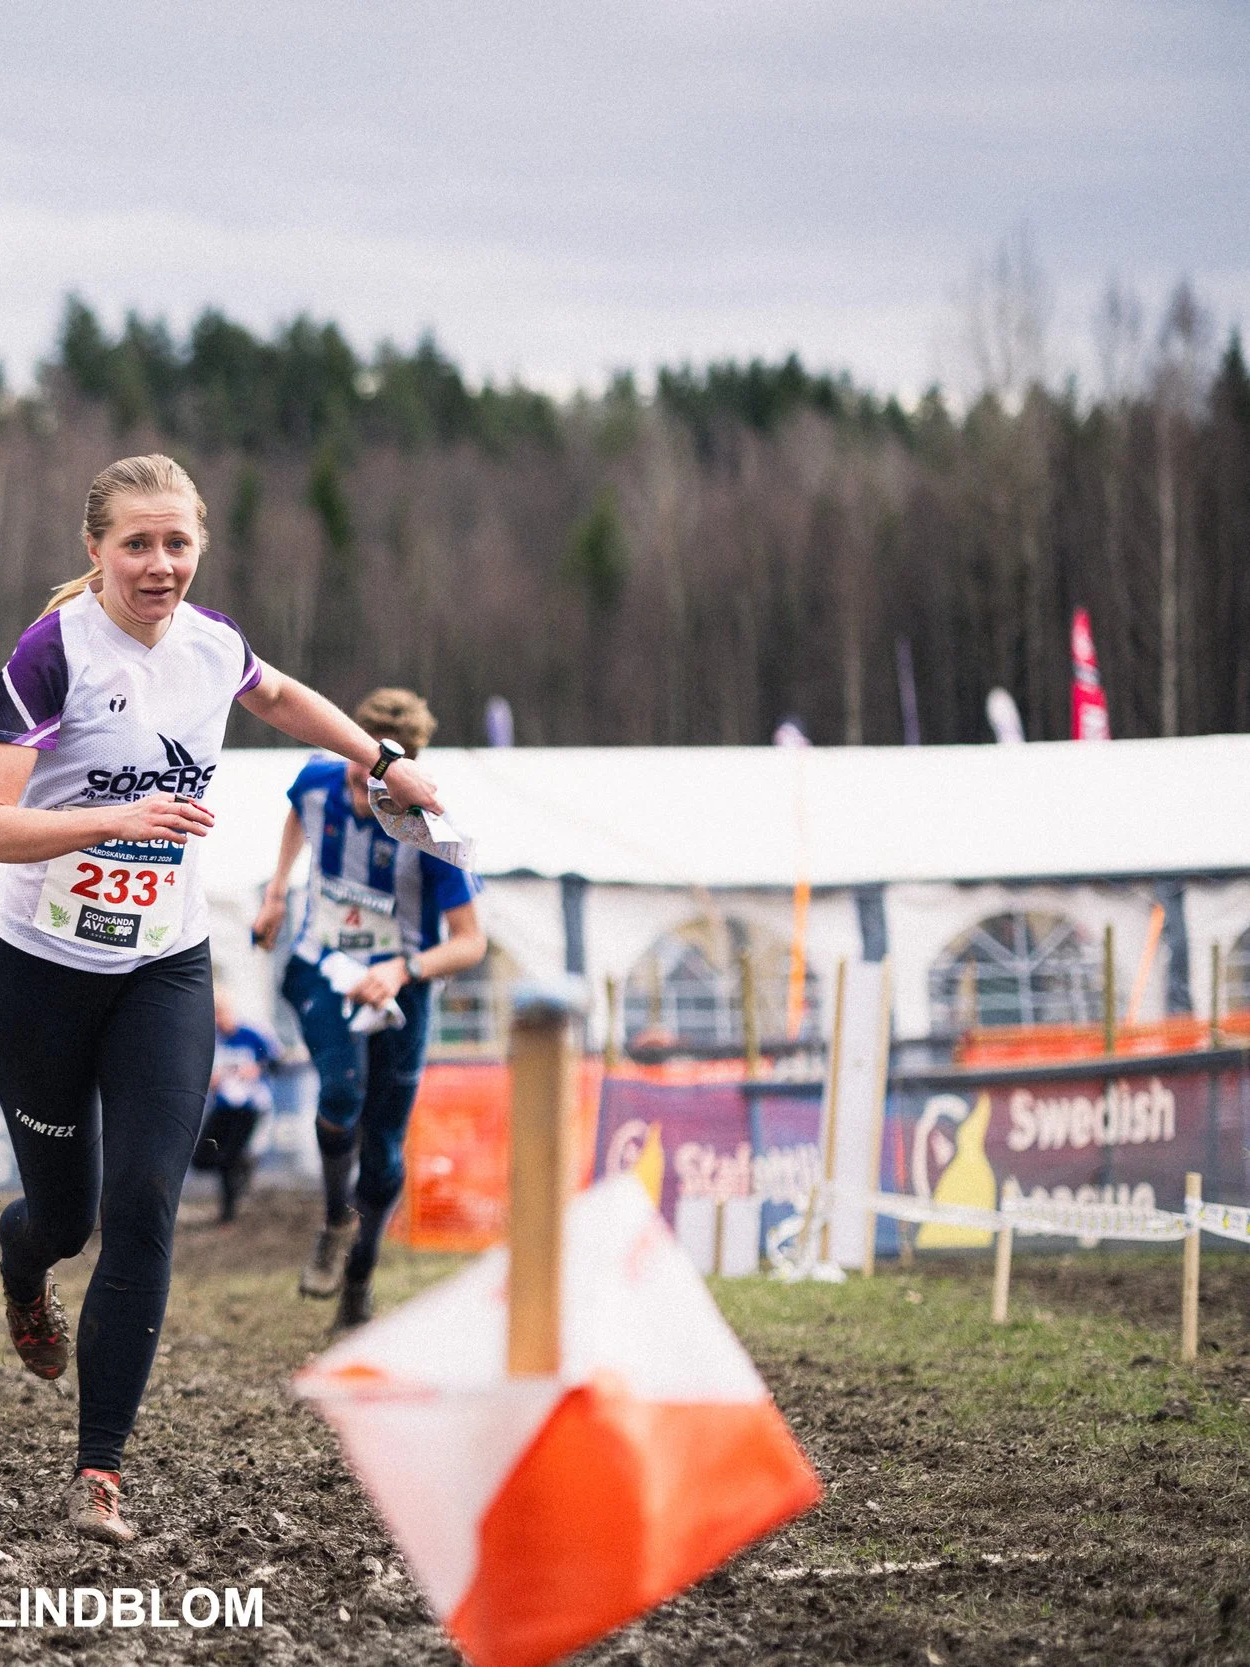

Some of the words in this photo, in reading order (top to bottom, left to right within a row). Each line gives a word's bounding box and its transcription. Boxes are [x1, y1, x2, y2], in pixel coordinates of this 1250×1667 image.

[87, 764, 217, 795] SÖDERS
[70, 862, 158, 907] 233
[163, 871, 176, 887] 4
[85, 911, 135, 927] GODKÄNDA
[15, 1108, 77, 1137] TRIMTEX
[1007, 1076, 1177, 1152] Swedish
